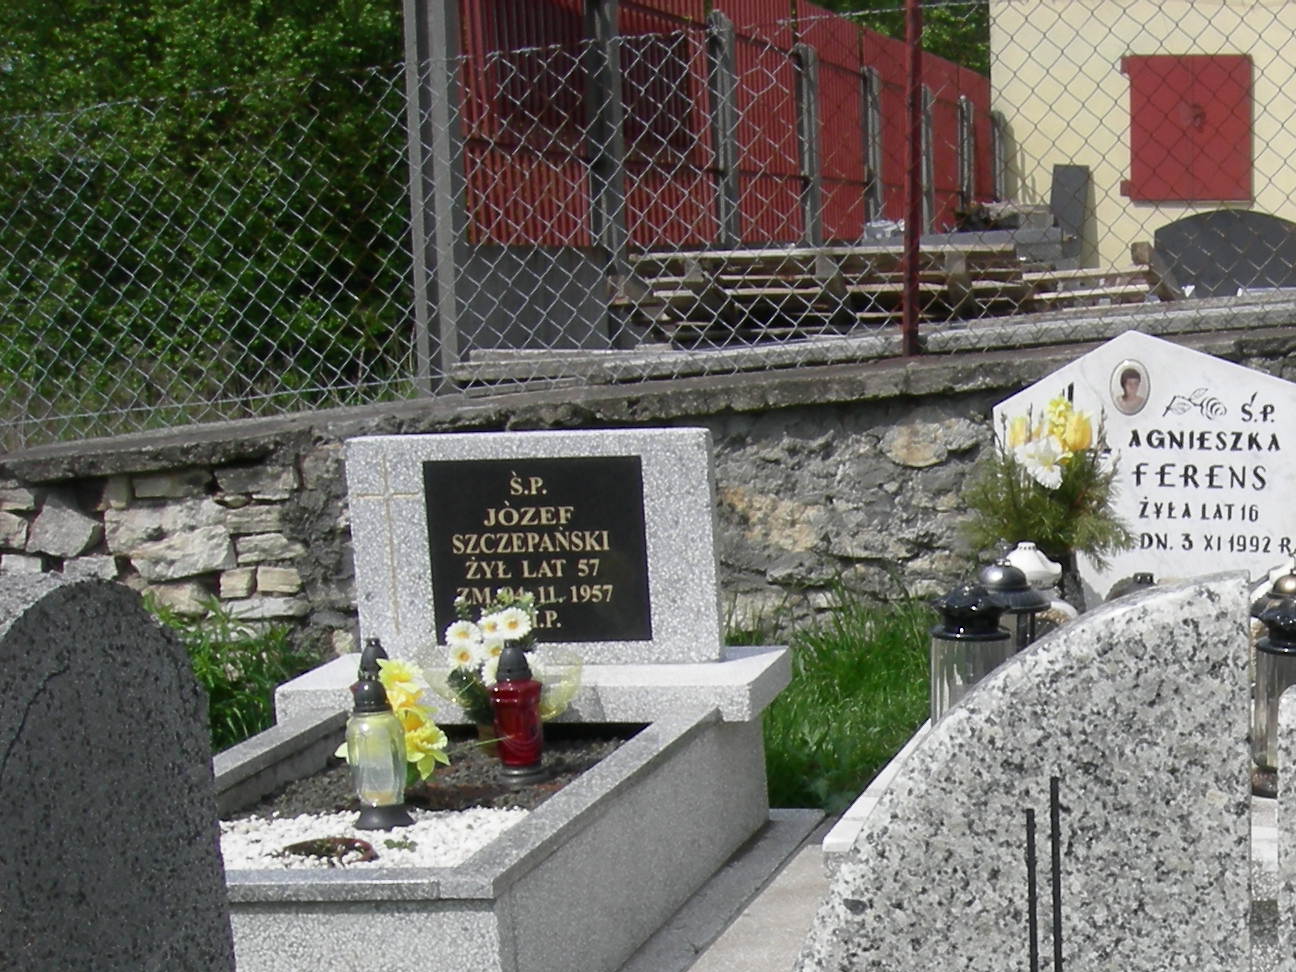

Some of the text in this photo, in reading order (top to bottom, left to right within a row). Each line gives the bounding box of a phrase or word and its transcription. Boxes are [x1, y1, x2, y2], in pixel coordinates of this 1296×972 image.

[1128, 428, 1281, 452] AGNIESZKA
[1132, 462, 1267, 491] FERENS
[1138, 496, 1259, 523] ŻYŁA LAT 16
[1181, 532, 1194, 551] 3
[1204, 534, 1222, 553] XI
[1229, 534, 1271, 553] 1992
[465, 556, 601, 580] ŻYŁ LAT 57
[570, 584, 614, 604] 1957
